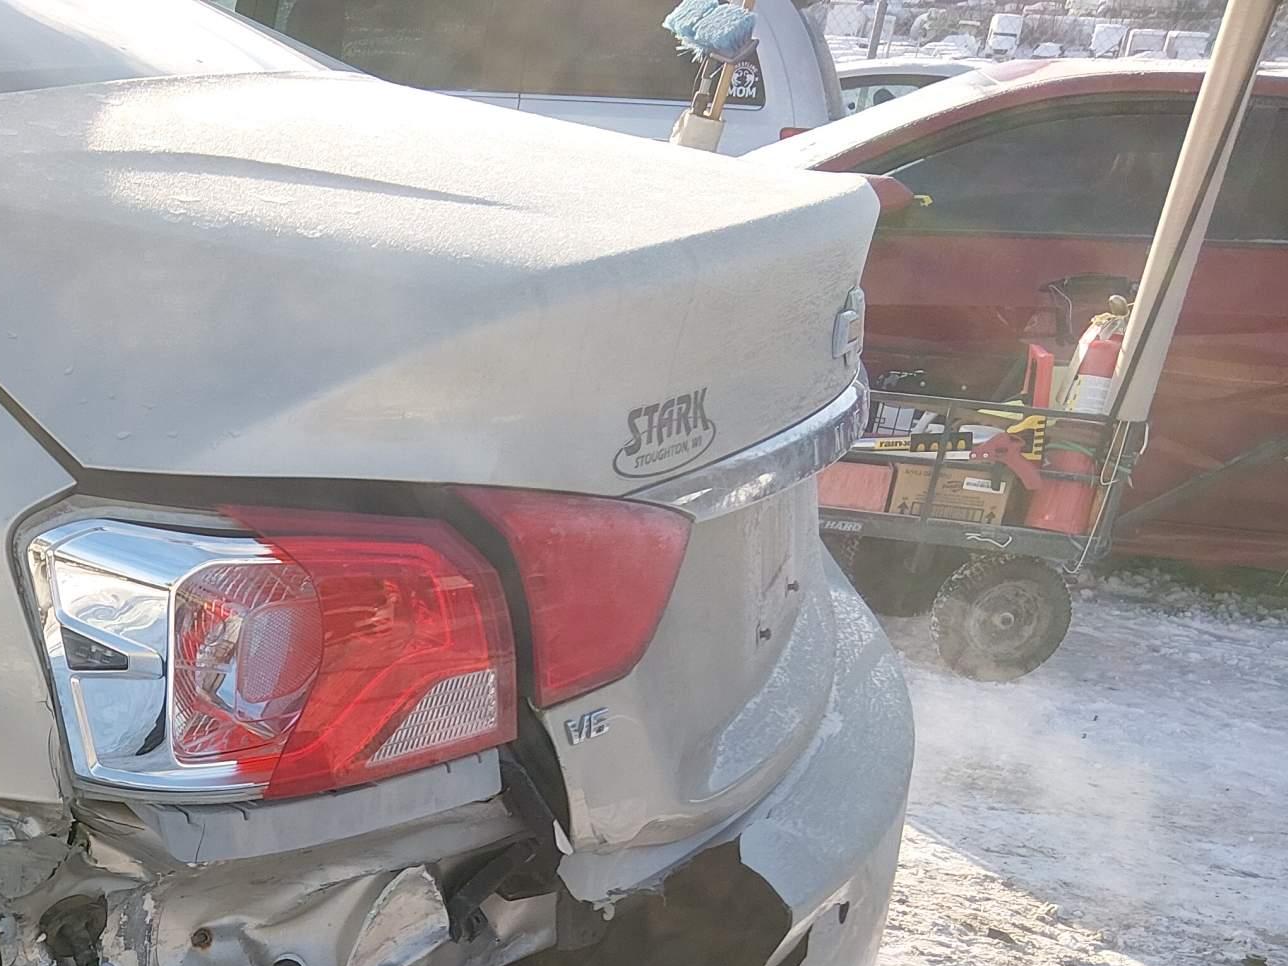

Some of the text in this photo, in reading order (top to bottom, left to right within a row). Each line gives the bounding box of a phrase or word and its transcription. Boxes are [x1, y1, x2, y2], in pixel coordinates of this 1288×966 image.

[727, 86, 757, 98] MOM
[623, 387, 710, 456] STARK
[634, 441, 689, 468] STOUGHTON,
[564, 706, 610, 746] V6
